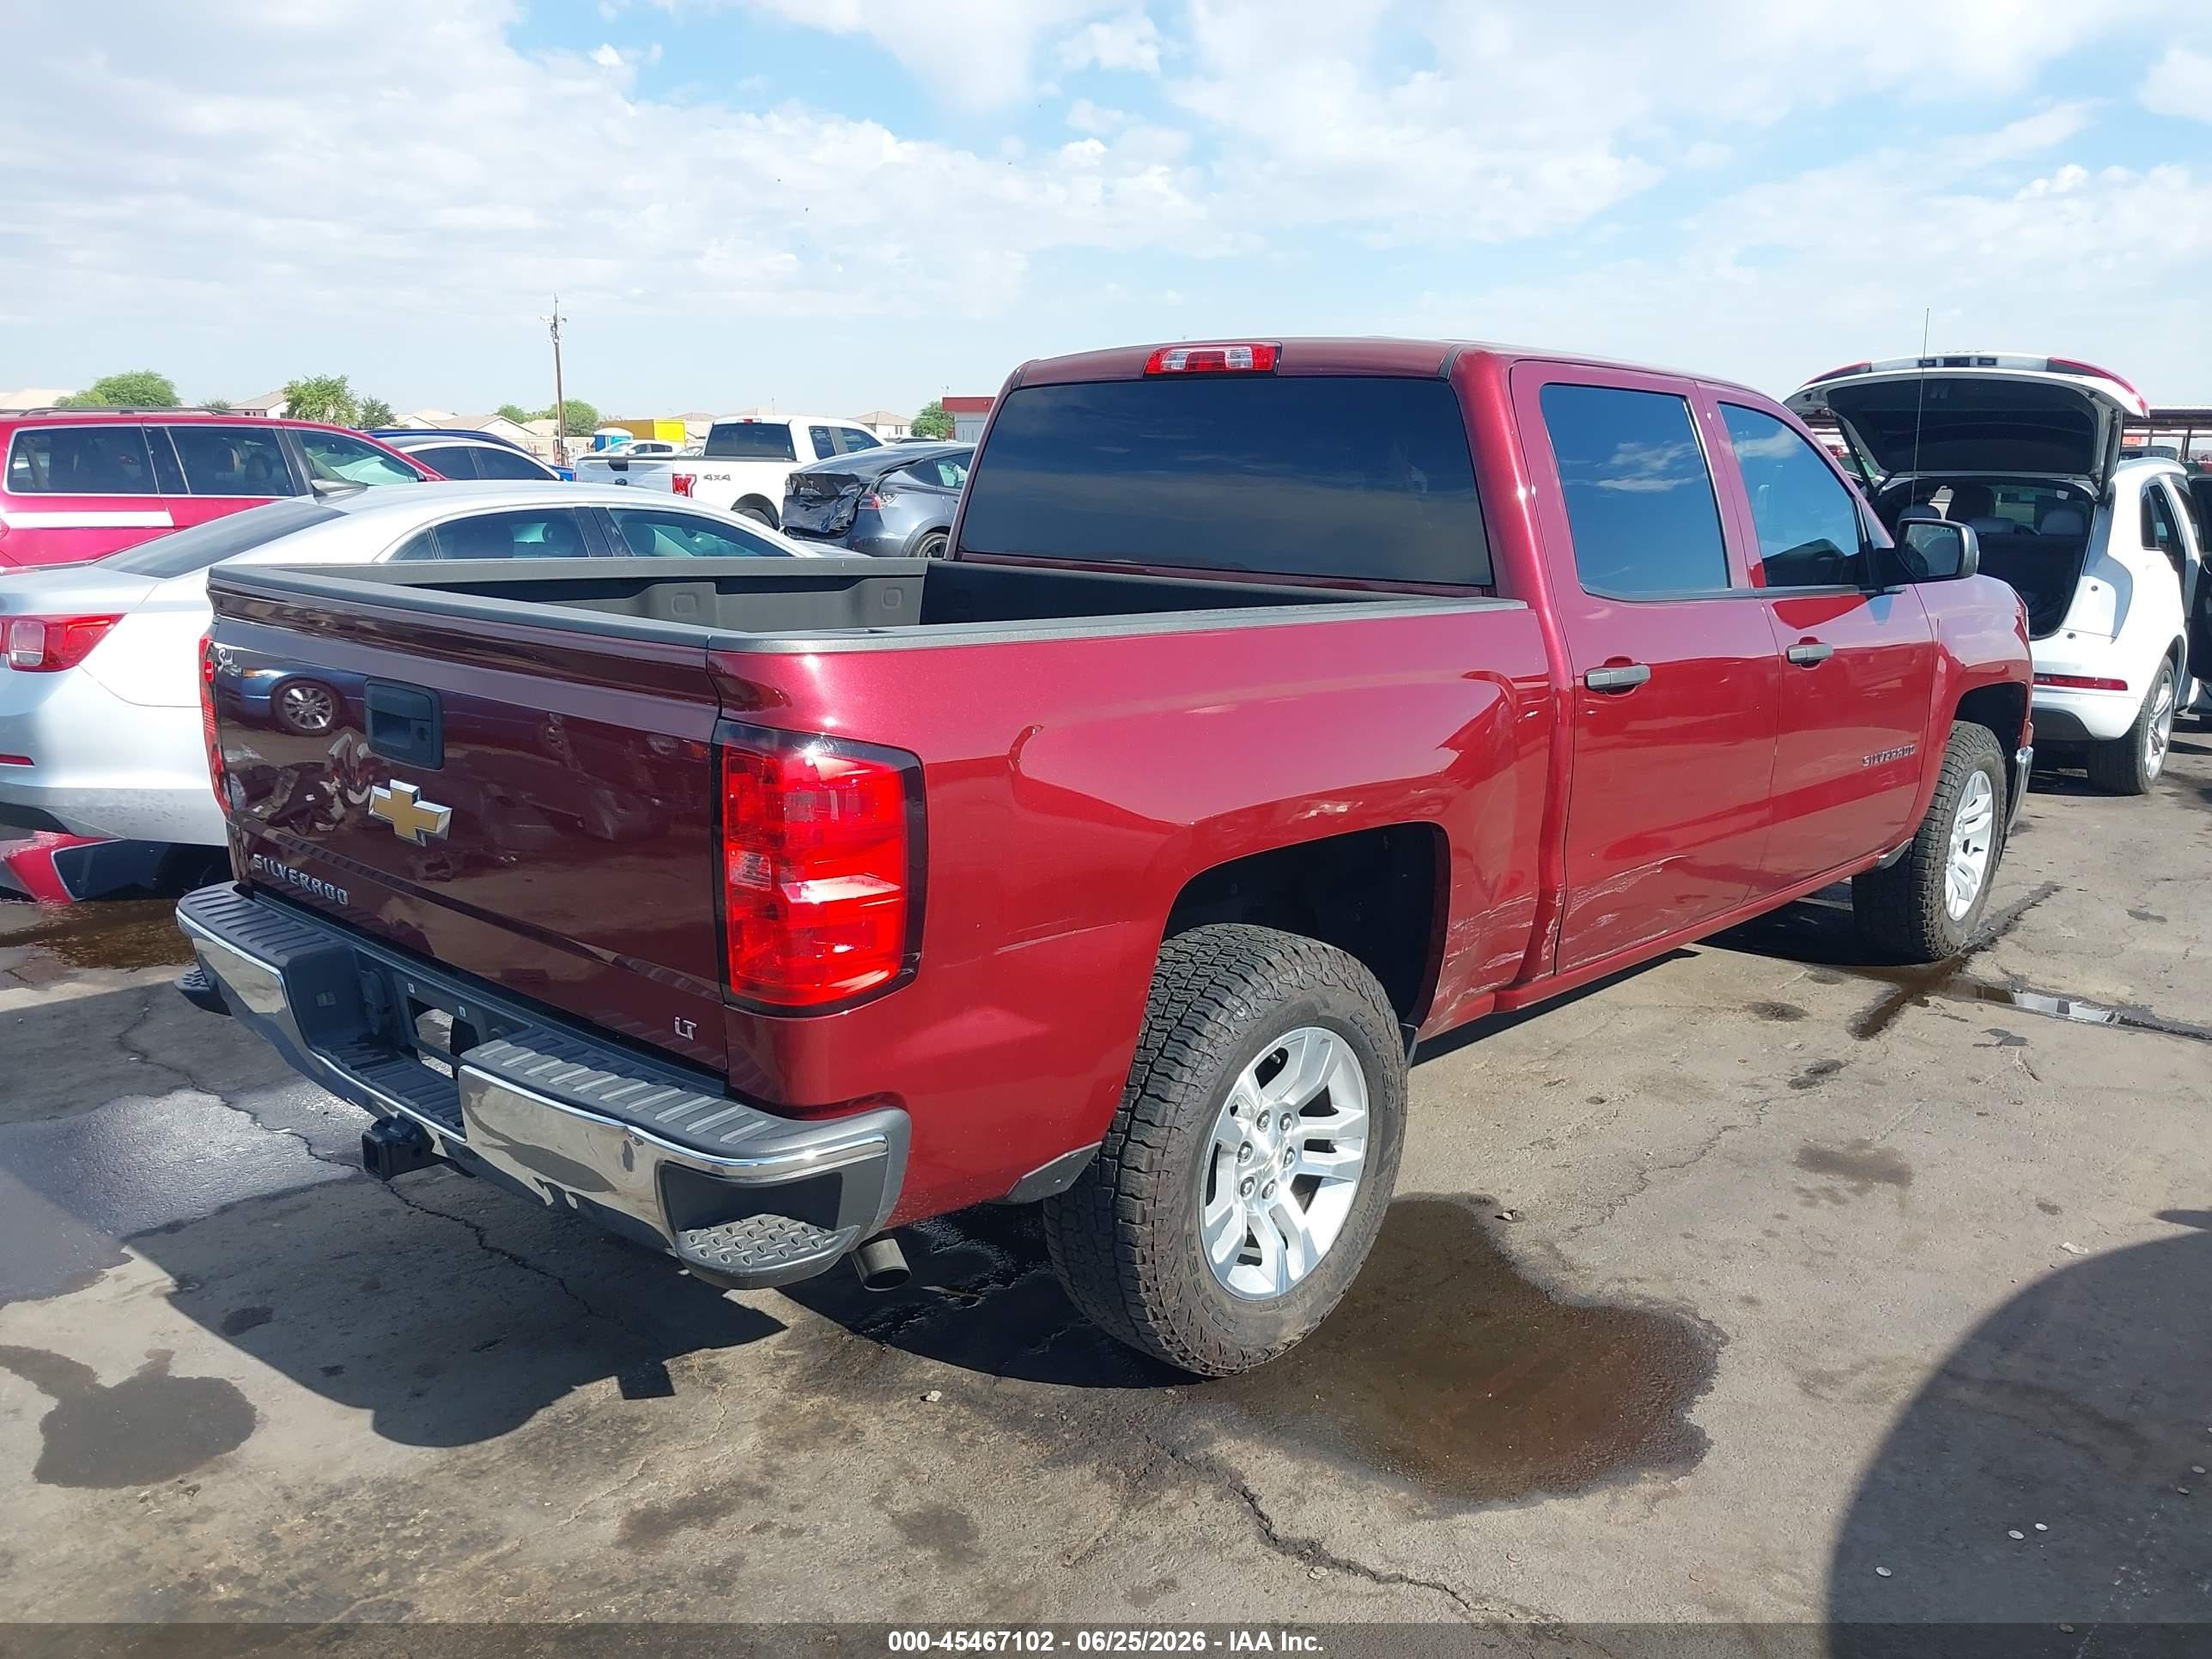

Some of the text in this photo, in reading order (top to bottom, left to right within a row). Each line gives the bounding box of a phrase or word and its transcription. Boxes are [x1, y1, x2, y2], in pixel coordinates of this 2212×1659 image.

[1862, 744, 1916, 767] SILVERADO
[253, 854, 349, 906] SILVERADO
[675, 1017, 697, 1040] LT
[1350, 1009, 1395, 1112] COOPER
